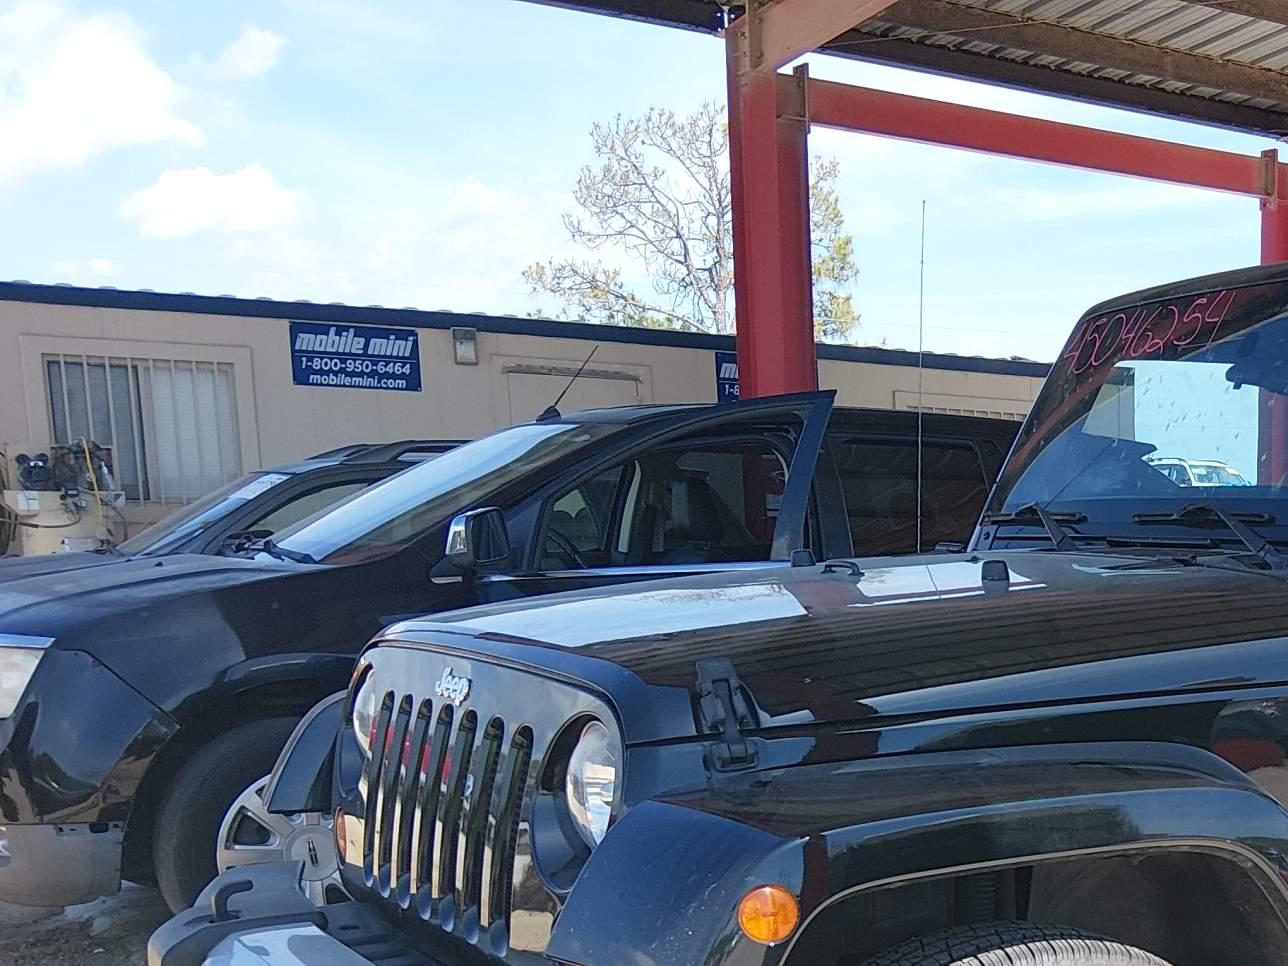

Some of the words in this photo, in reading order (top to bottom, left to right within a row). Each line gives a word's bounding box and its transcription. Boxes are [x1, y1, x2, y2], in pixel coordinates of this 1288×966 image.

[295, 326, 365, 354] mobile
[368, 334, 416, 357] mini
[1064, 290, 1236, 375] 45046254
[301, 357, 411, 375] 1-800-950-6464
[308, 373, 407, 389] mobilemini.com
[435, 666, 470, 706] Jeep
